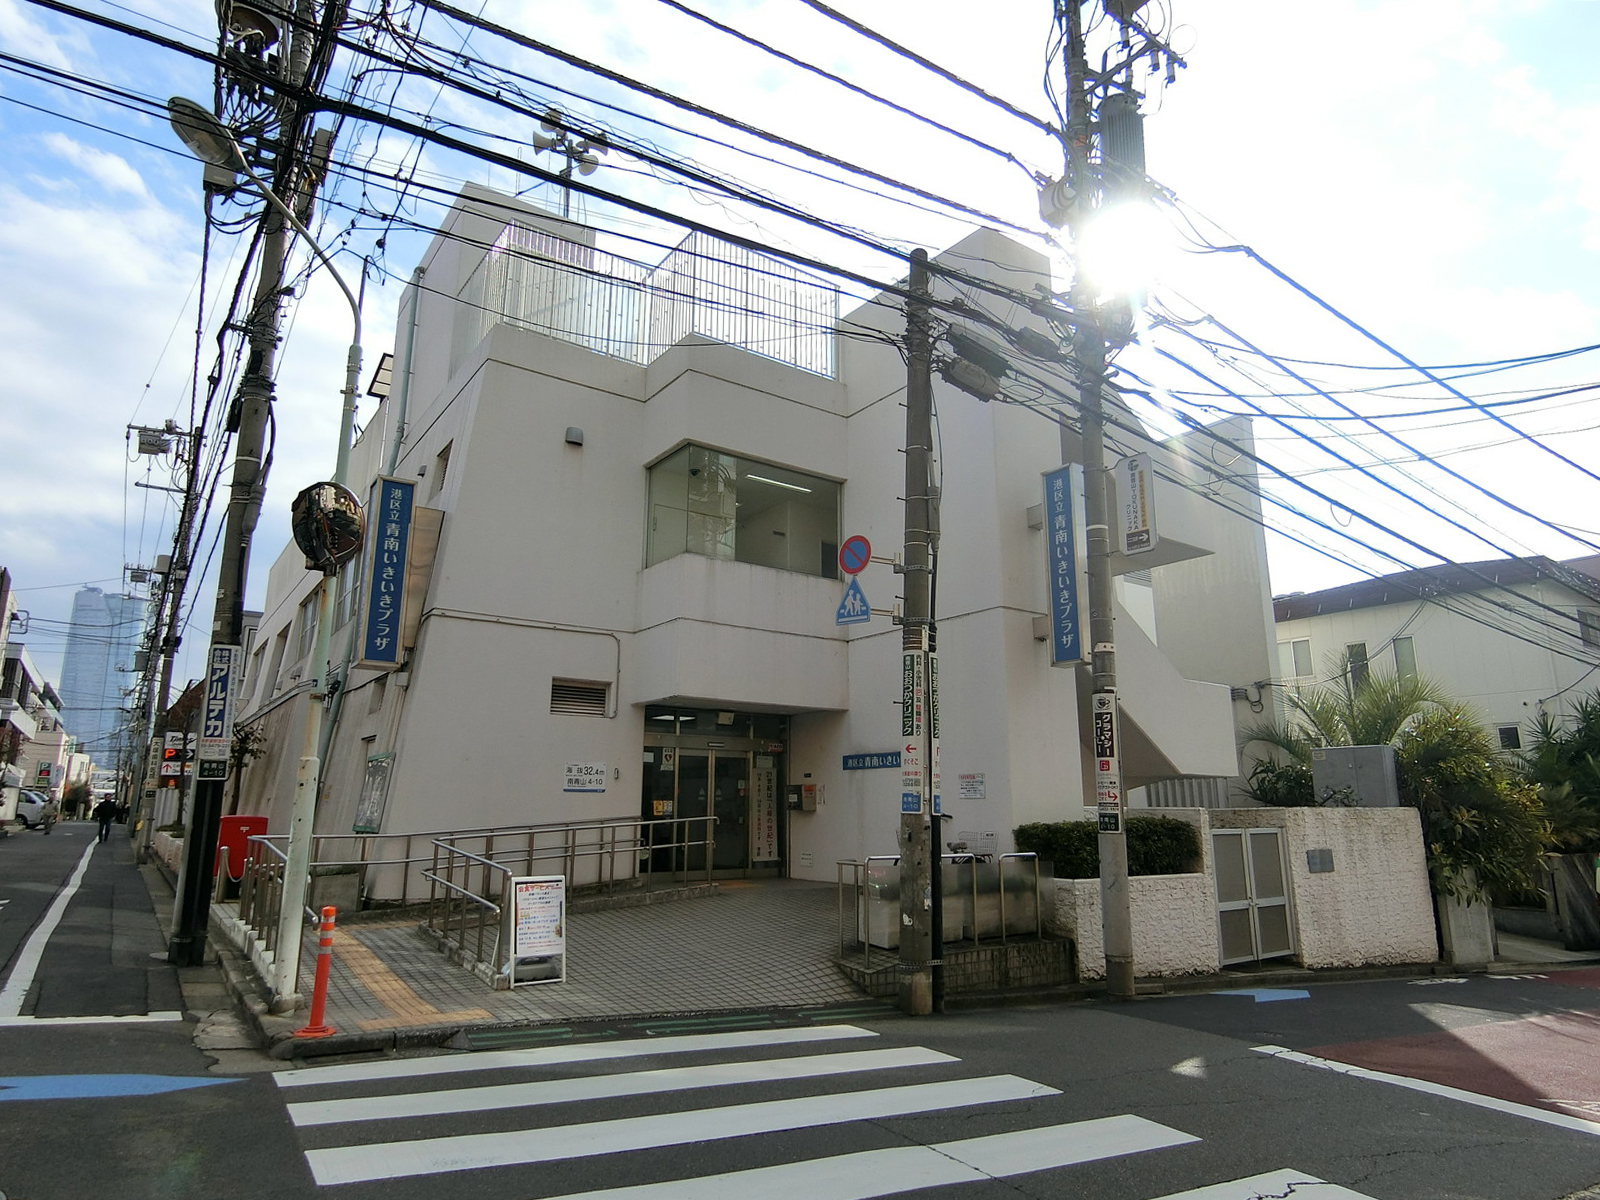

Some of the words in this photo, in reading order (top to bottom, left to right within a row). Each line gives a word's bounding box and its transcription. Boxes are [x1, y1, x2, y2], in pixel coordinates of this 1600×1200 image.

[374, 488, 403, 651] 港区立青南いきいきプラザ
[1053, 479, 1074, 648] 港区立青南いきいきプラザ
[205, 664, 228, 736] アルテカ
[903, 670, 913, 735] おおつかクリニック
[1102, 713, 1112, 756] グラマシー
